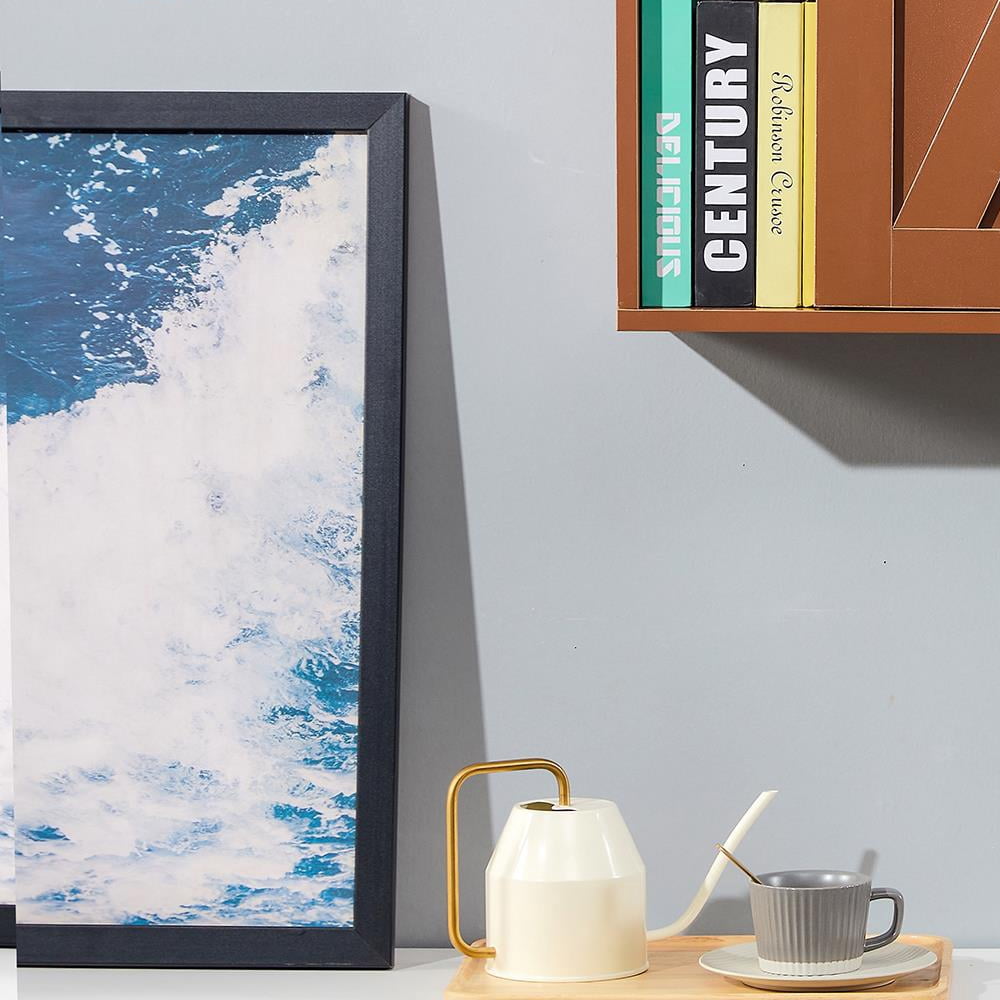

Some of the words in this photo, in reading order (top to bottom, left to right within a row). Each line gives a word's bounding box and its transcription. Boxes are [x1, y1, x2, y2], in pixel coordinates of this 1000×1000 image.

[703, 33, 748, 273] CENTURY
[770, 71, 794, 162] Robinson
[656, 112, 681, 278] DELICIOUS
[770, 170, 794, 235] Crusoe
